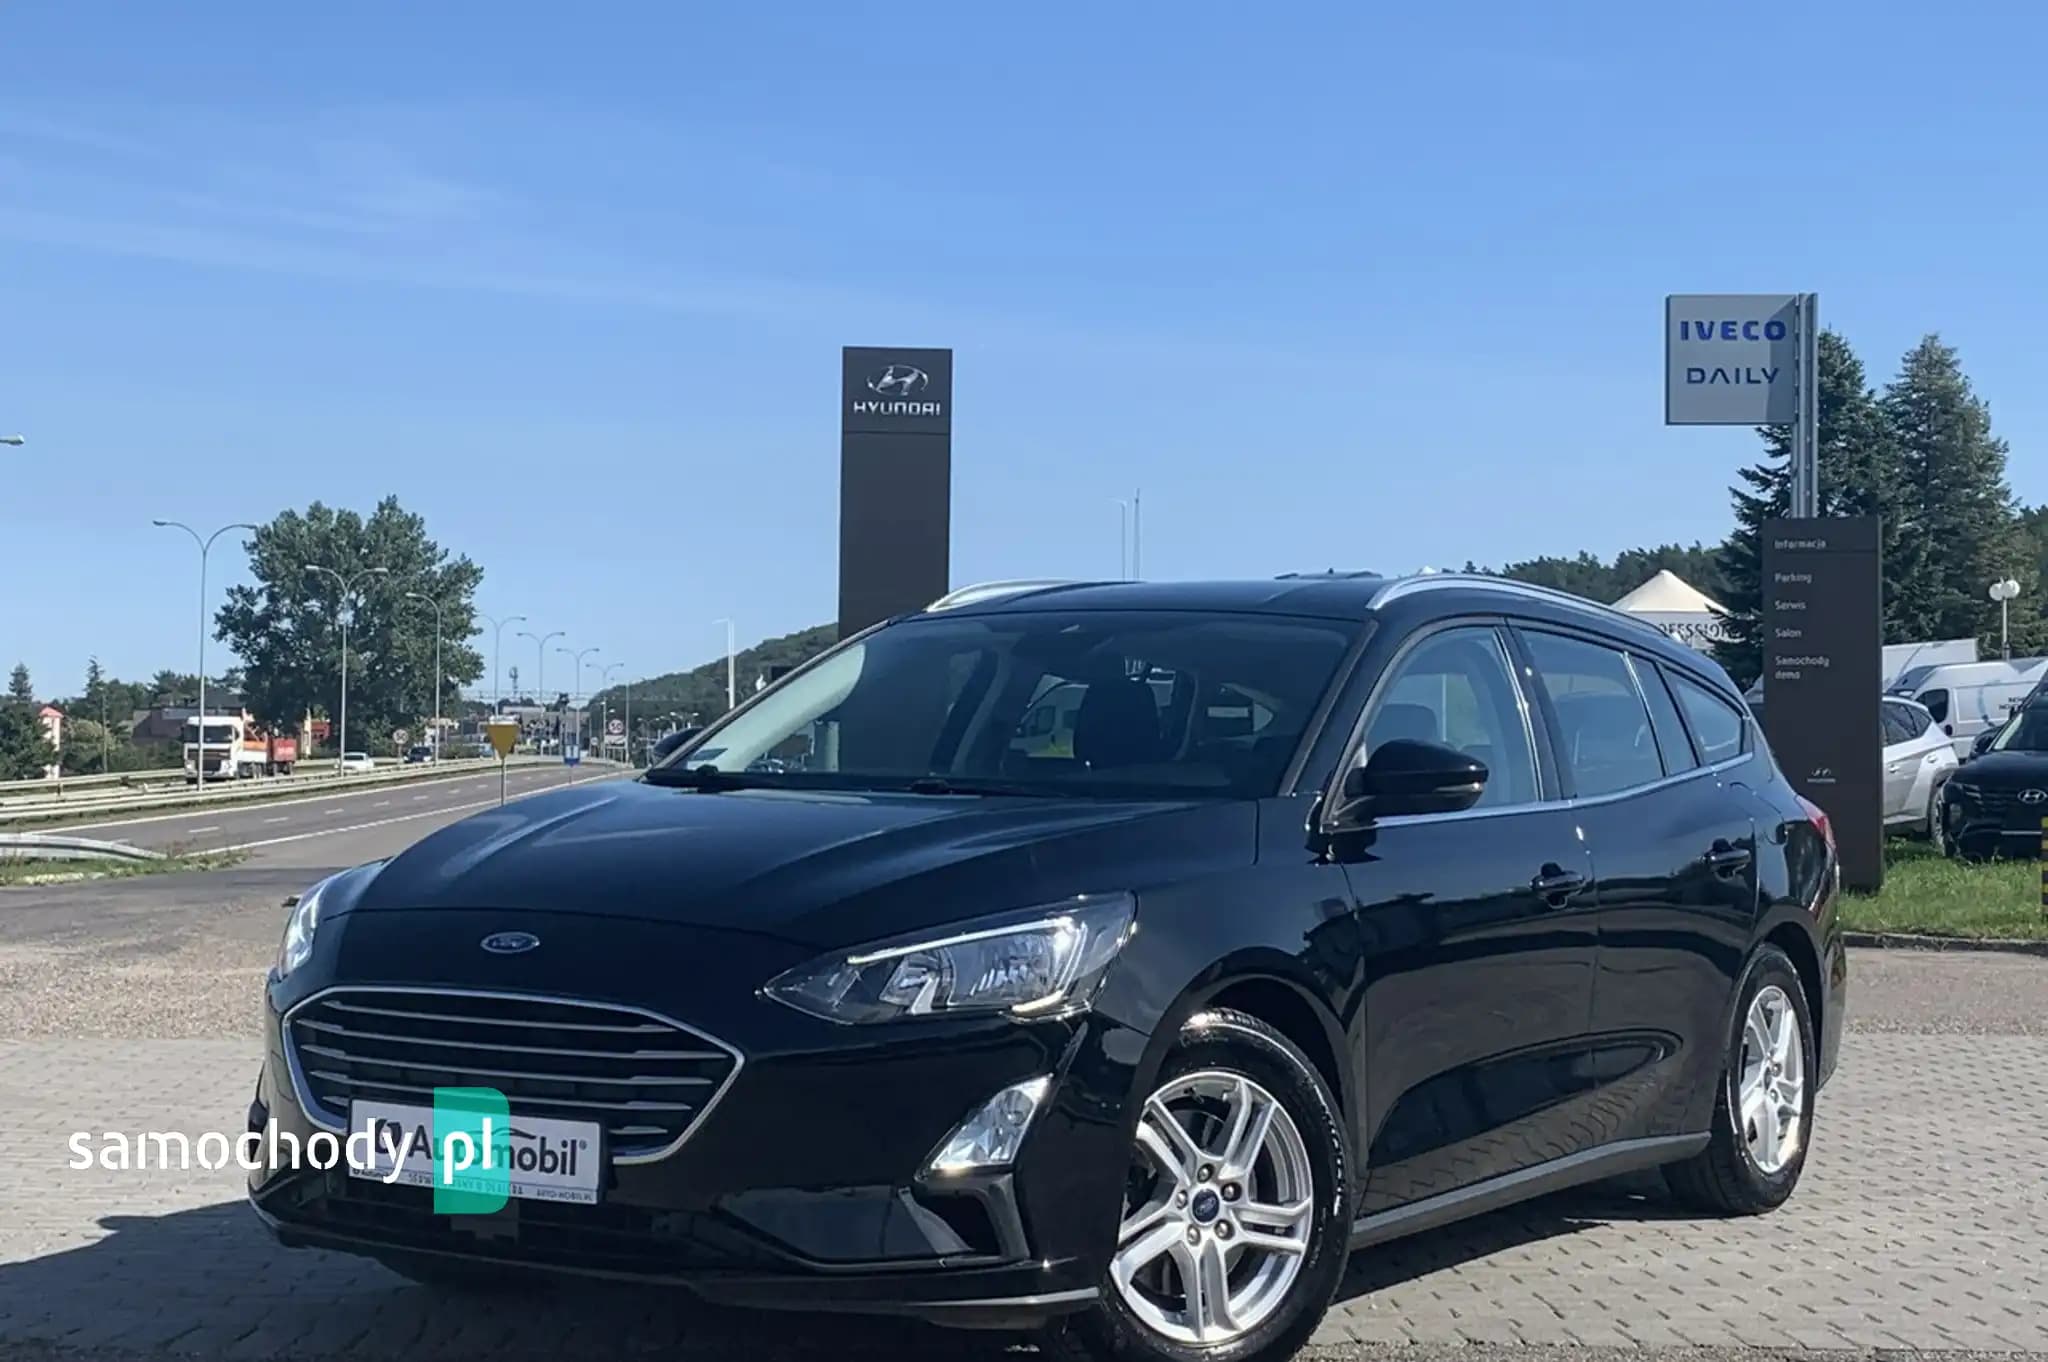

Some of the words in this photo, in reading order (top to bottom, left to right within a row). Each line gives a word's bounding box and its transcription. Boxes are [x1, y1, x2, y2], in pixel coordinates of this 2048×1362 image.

[1680, 320, 1786, 341] IVECO
[1686, 367, 1779, 384] DAILY
[853, 401, 941, 415] HYUNDAI
[1774, 572, 1812, 584] Parking
[1774, 600, 1806, 610] Serwis
[1775, 628, 1802, 638] Salon
[1775, 655, 1830, 668] Samochody
